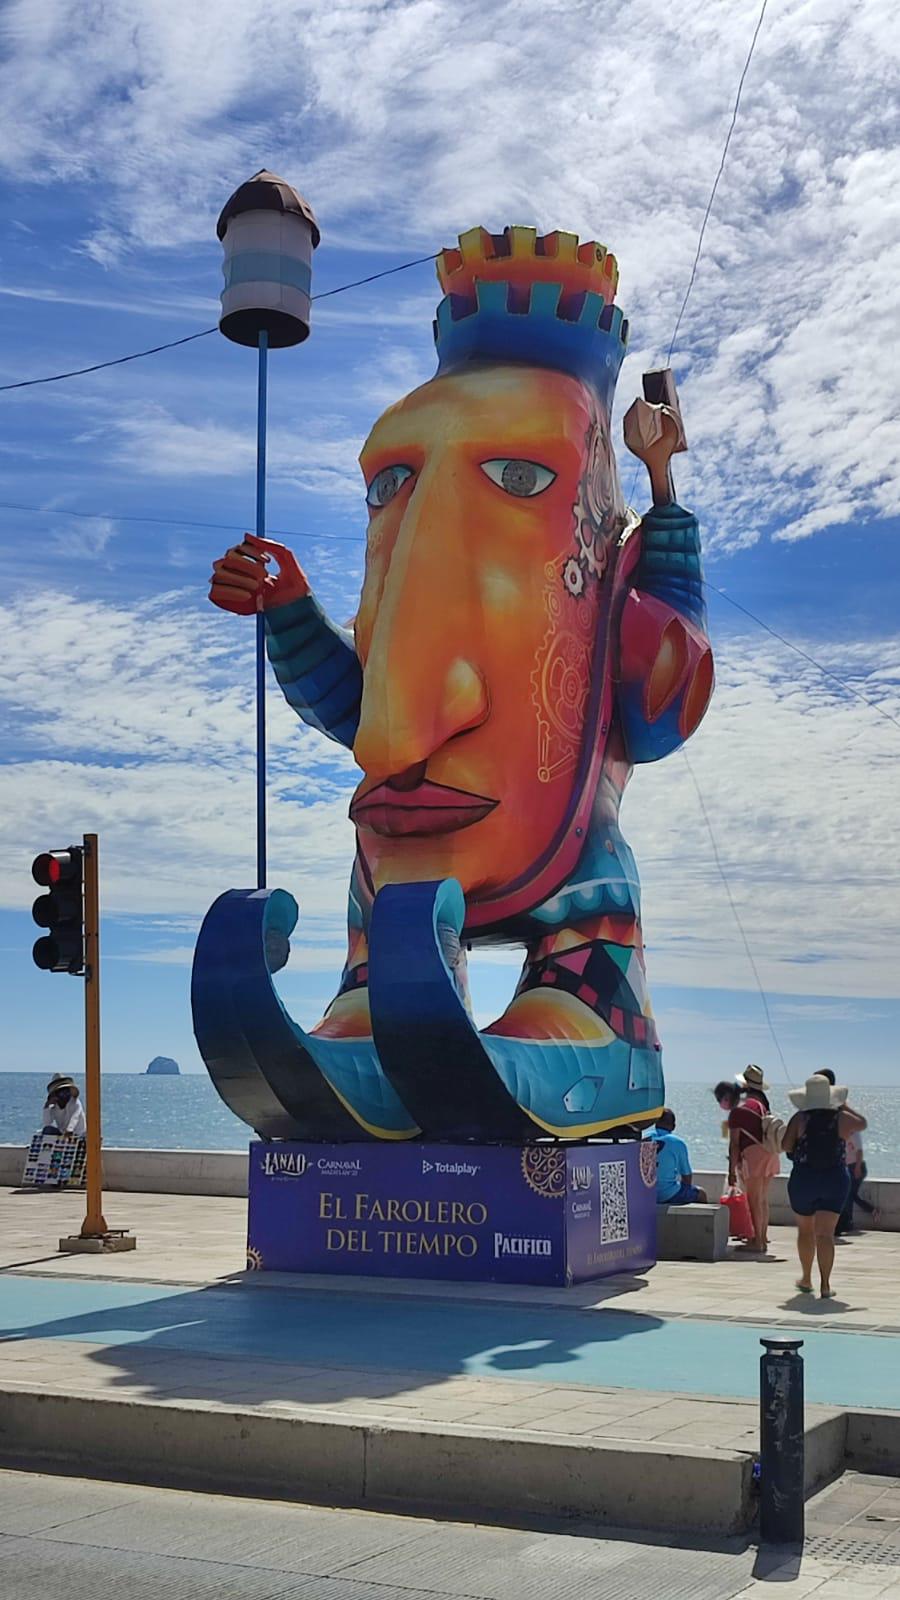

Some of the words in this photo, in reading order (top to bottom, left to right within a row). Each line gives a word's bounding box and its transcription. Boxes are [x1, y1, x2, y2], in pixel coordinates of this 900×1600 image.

[317, 1158, 362, 1170] CARNAVAL
[434, 1162, 479, 1176] Totalplay
[319, 1192, 347, 1220] EL
[355, 1194, 487, 1225] FAROLERO
[326, 1228, 374, 1253] DEL
[378, 1231, 478, 1257] TIEMPO
[494, 1232, 553, 1259] PACIFICO
